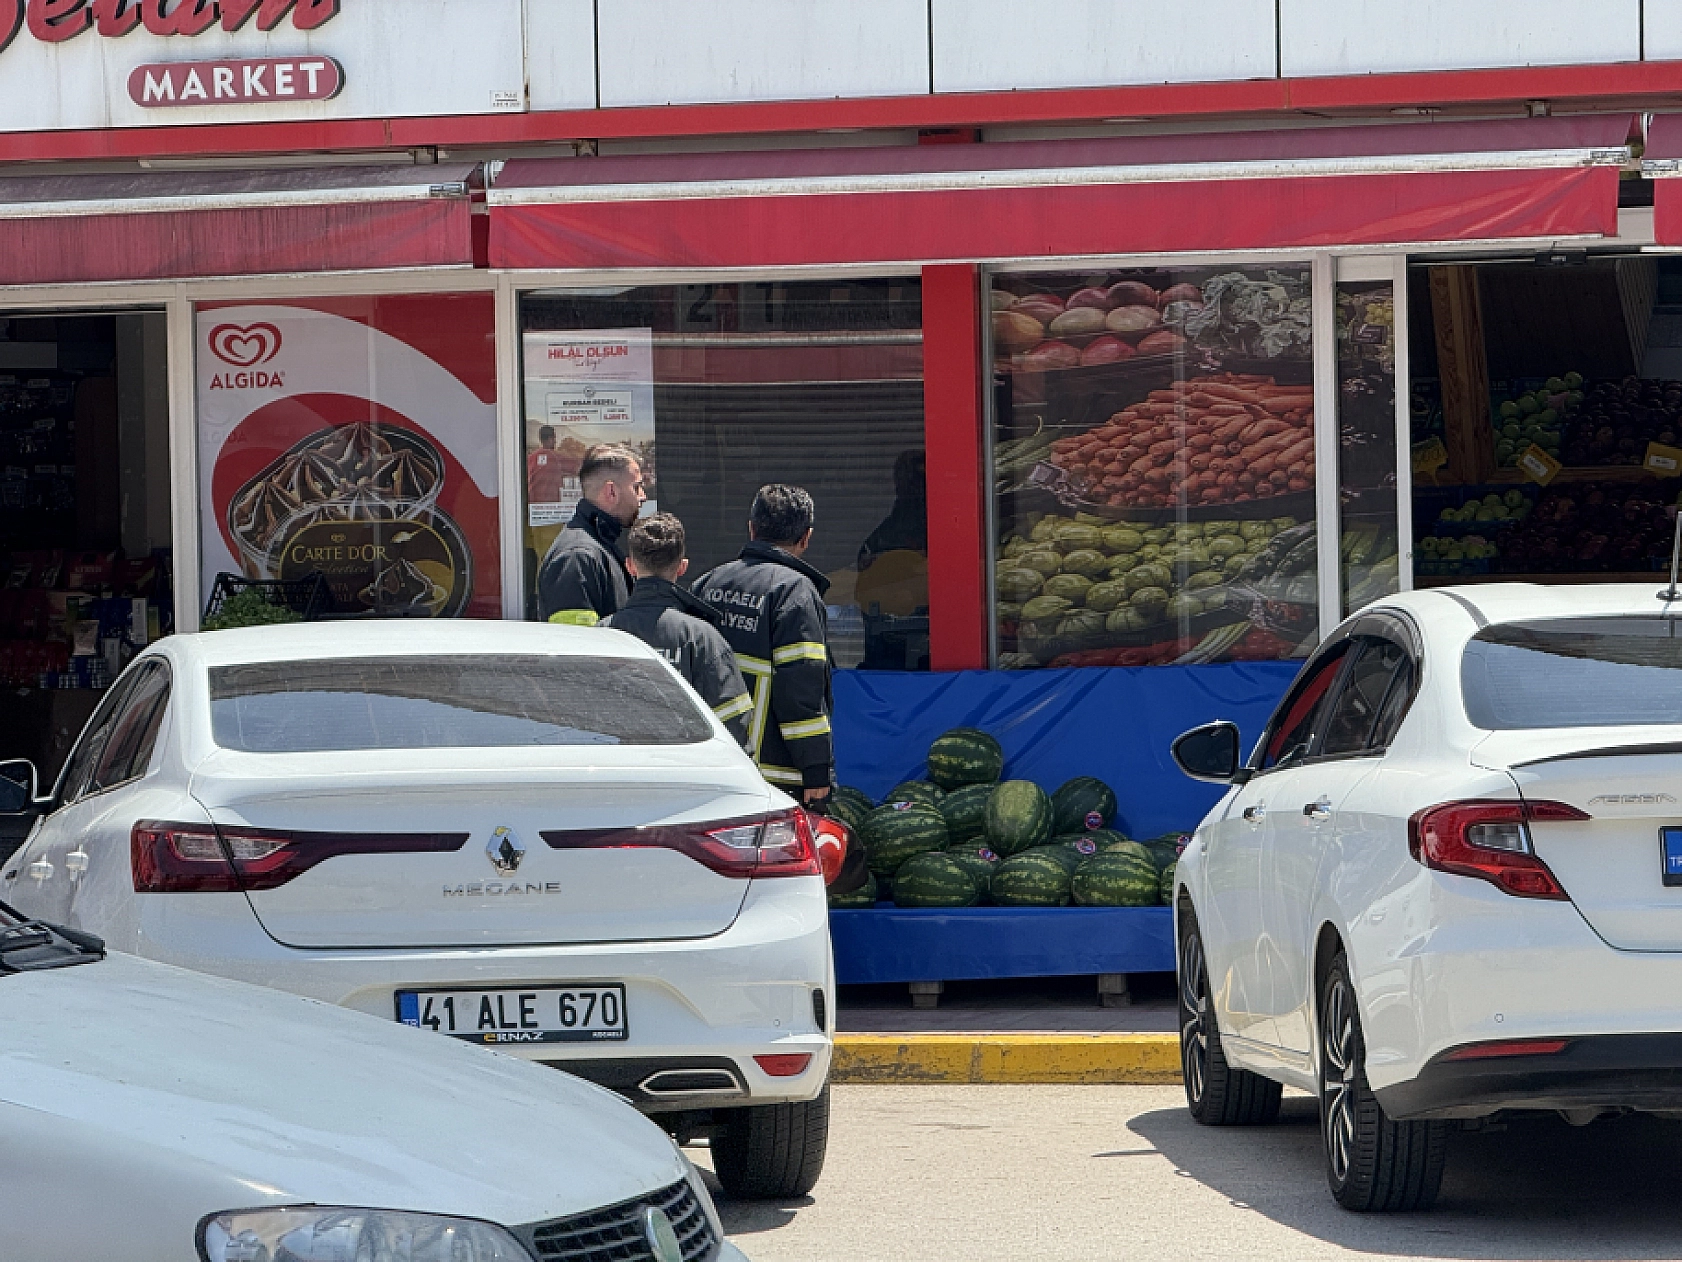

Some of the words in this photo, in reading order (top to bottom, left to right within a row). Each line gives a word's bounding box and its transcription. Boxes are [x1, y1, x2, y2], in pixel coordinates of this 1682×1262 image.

[142, 61, 326, 103] MARKET
[291, 544, 344, 564] CARTE
[347, 543, 393, 563] D'OR
[442, 881, 563, 897] MEGANE
[421, 996, 456, 1031] 41
[477, 993, 539, 1030] ALE
[558, 991, 619, 1027] 670
